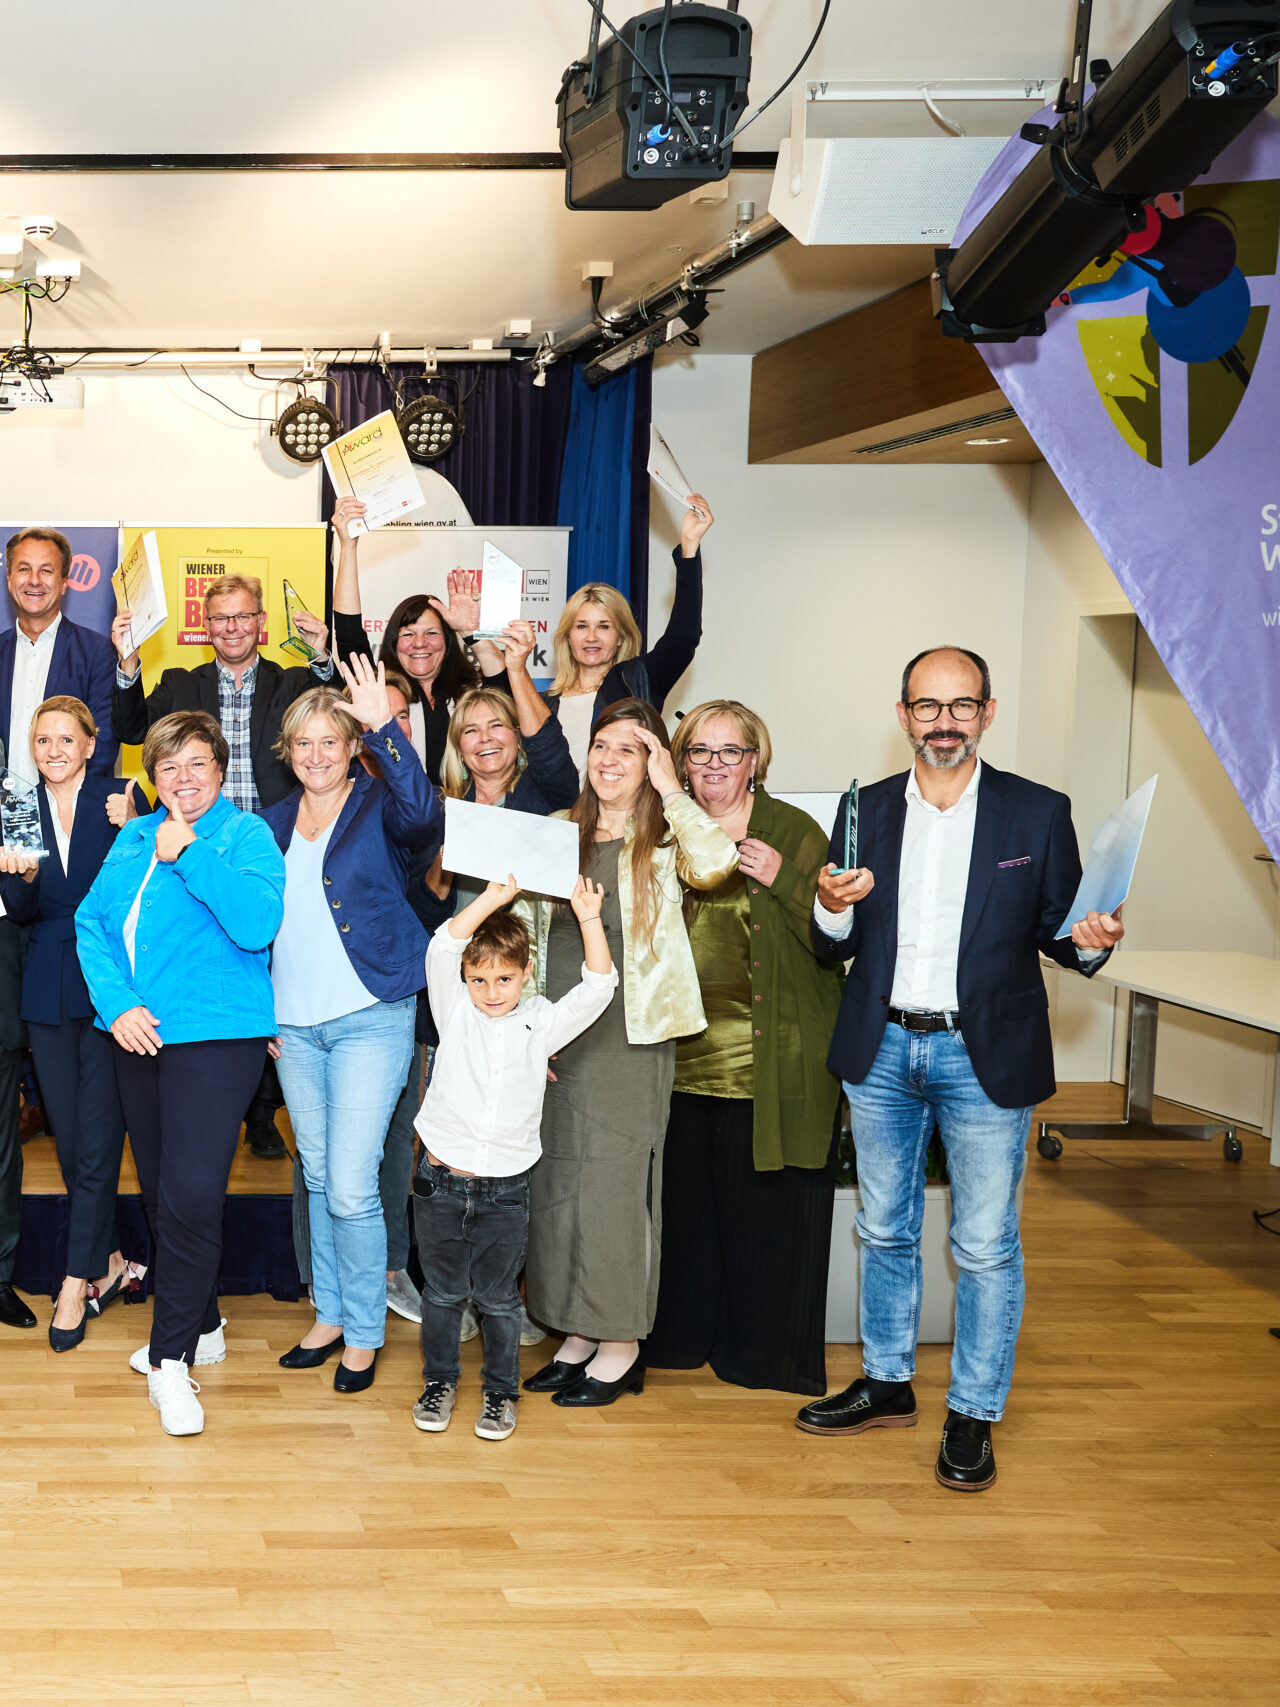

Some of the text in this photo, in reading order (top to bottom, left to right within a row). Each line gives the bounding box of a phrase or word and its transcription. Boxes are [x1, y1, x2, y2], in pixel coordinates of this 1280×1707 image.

[342, 426, 383, 456] Award
[1261, 503, 1280, 535] S
[186, 563, 225, 575] WIENER
